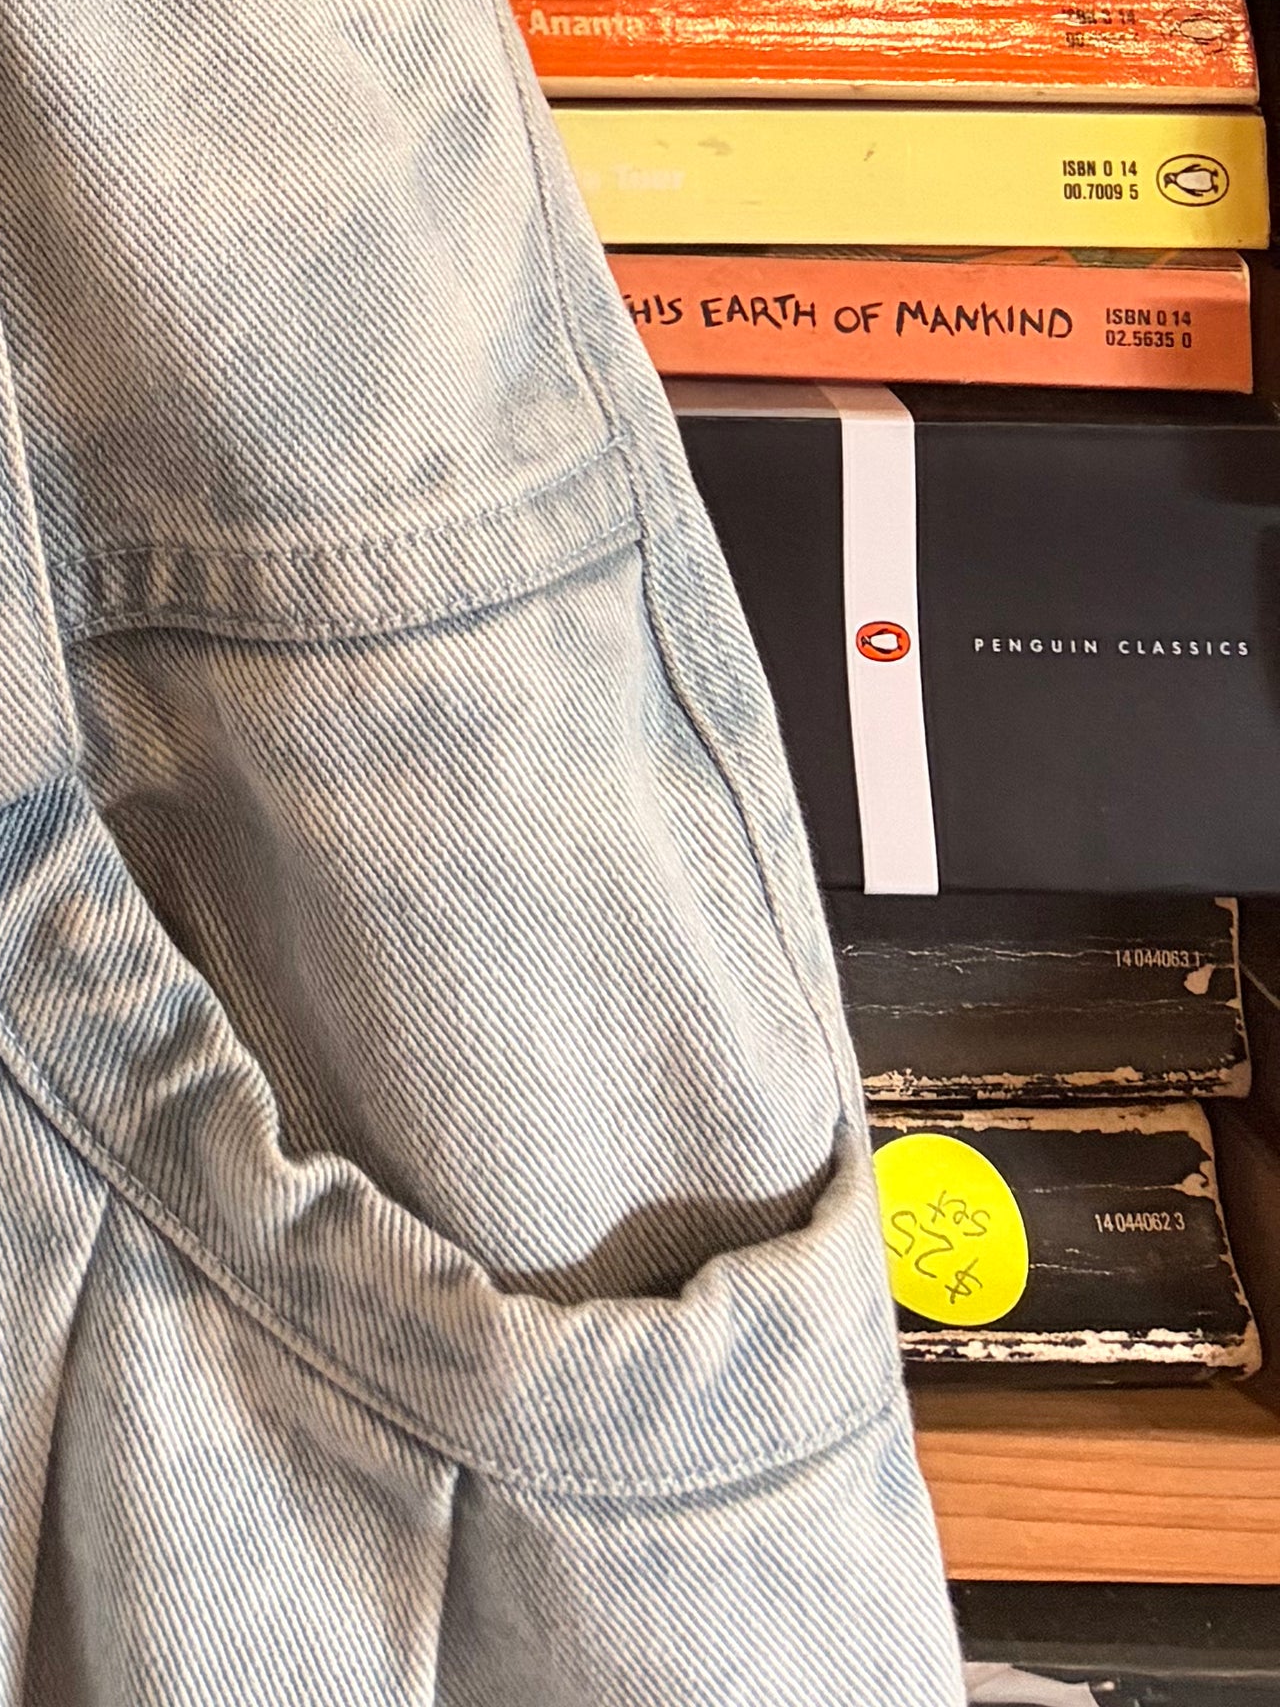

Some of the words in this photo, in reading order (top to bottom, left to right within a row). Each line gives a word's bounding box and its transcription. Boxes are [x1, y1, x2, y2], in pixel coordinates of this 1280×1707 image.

[1062, 159, 1097, 177] ISBN
[1121, 160, 1138, 177] 14
[1063, 183, 1124, 201] 00.7009
[700, 293, 818, 329] EARTH
[834, 300, 885, 334] OF
[896, 300, 1074, 340] MANKIND
[1105, 307, 1151, 326] ISBN
[1172, 310, 1192, 327] 14
[1105, 329, 1175, 348] 02.5635
[974, 637, 1099, 655] PENGUIN
[1118, 639, 1250, 658] CLASSICS
[1116, 1213, 1171, 1232] 044062
